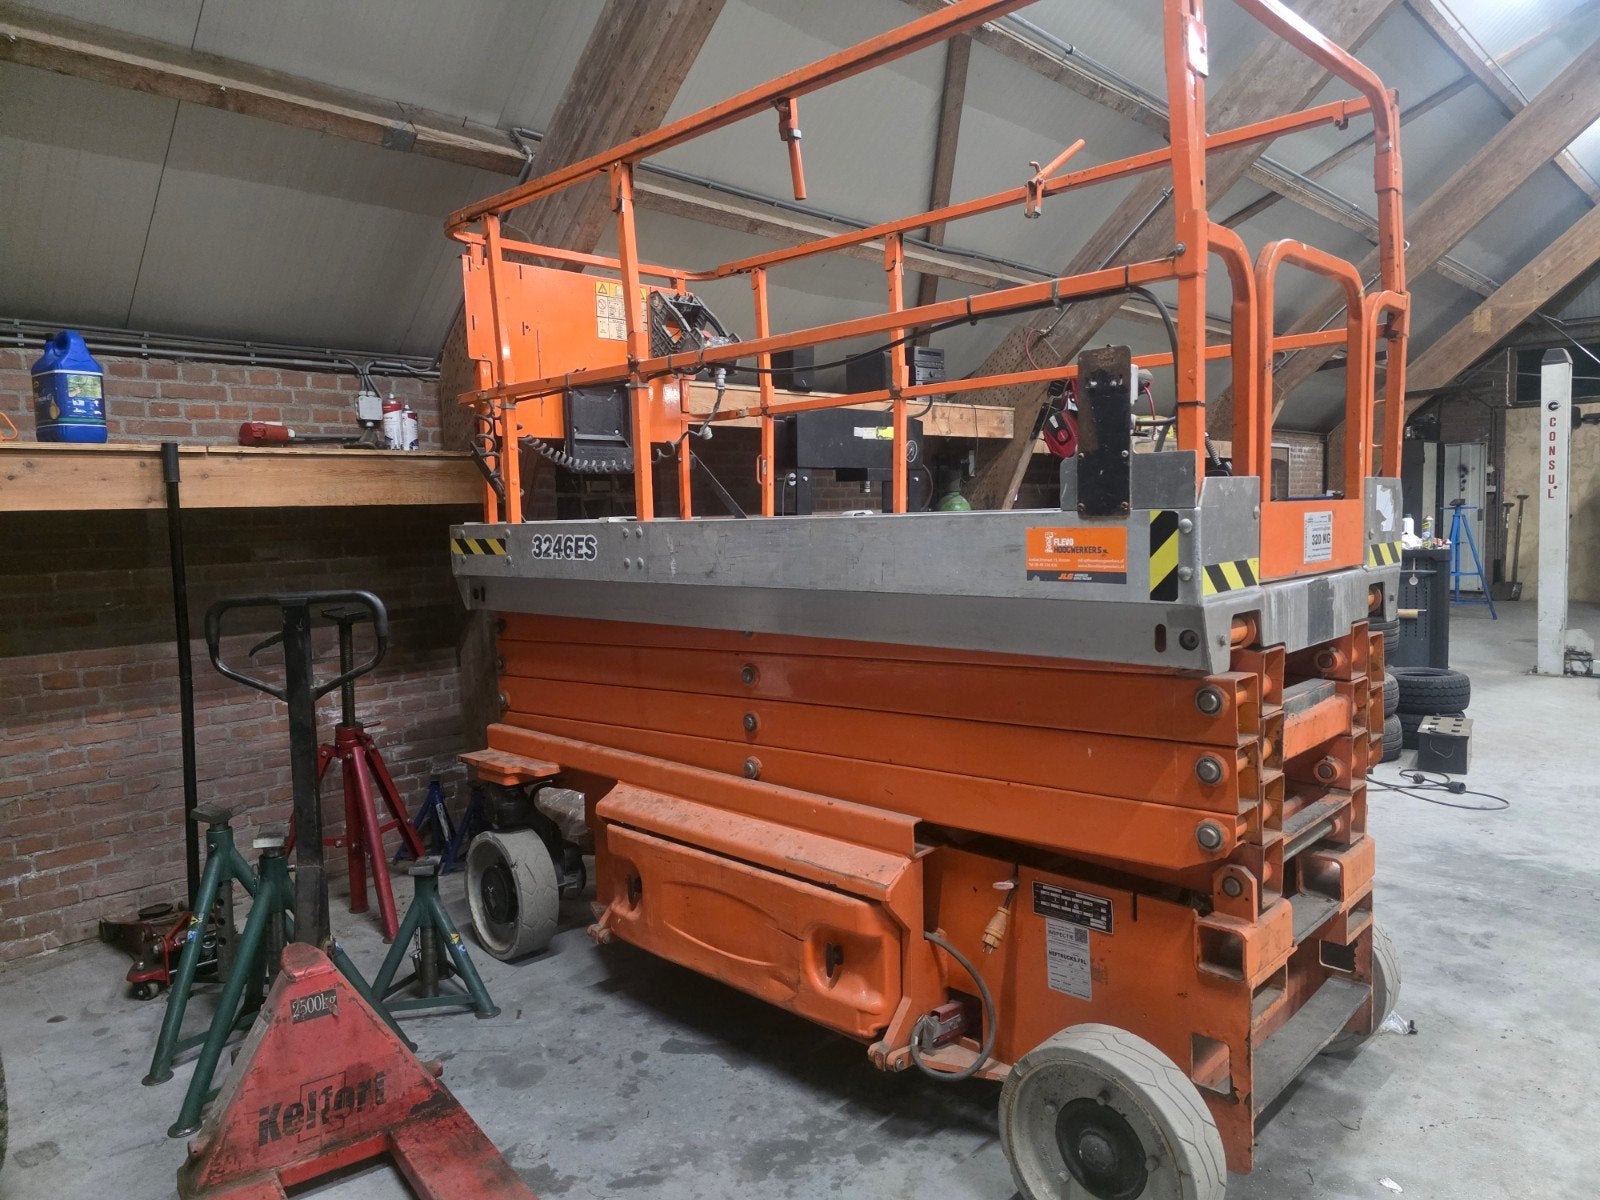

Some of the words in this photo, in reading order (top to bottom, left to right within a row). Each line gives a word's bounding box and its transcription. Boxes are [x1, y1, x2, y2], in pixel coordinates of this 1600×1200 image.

[1548, 417, 1557, 499] CONSUL
[532, 534, 598, 561] 3246ES
[1312, 534, 1322, 546] 320
[1323, 533, 1331, 544] KG
[292, 993, 337, 1018] 2500kg
[258, 1070, 387, 1147] Kelfort
